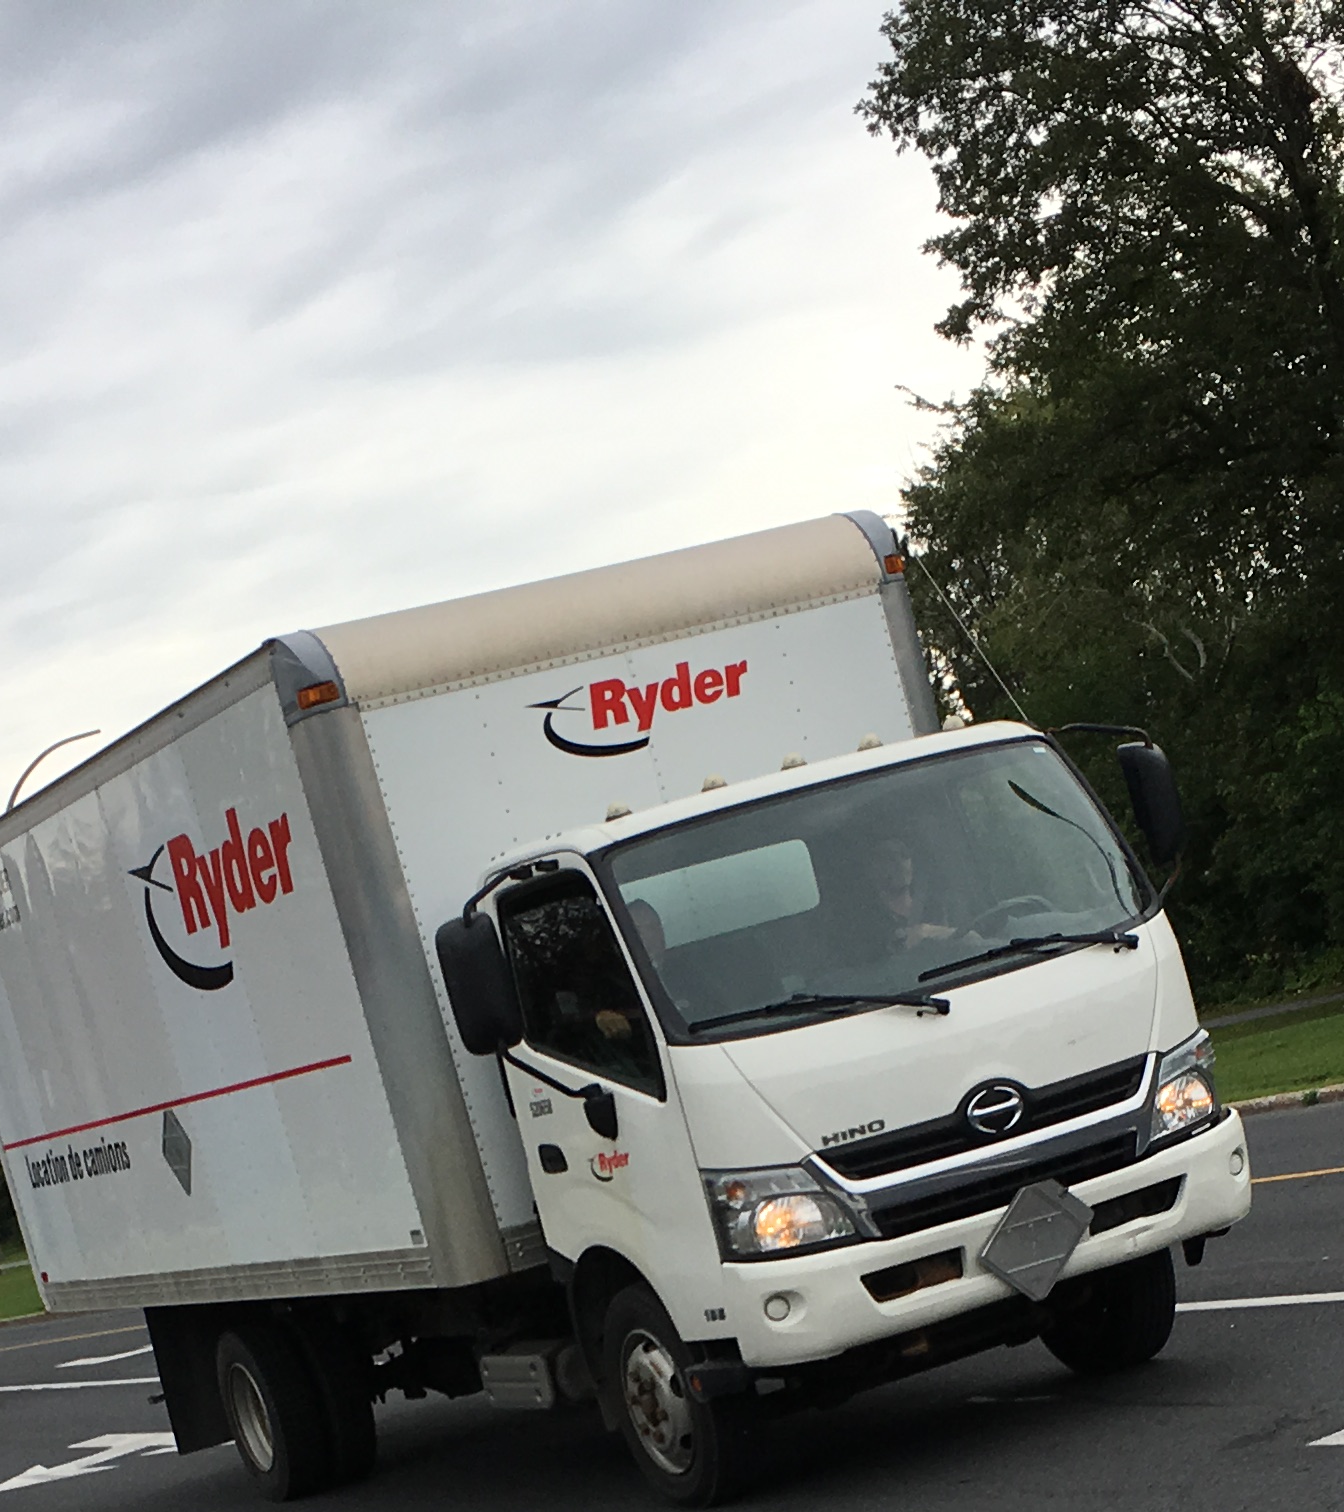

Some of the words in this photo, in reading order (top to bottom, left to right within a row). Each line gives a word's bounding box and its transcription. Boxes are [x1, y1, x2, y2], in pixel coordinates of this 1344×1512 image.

[589, 660, 747, 732] Ryder
[167, 807, 294, 949] Ryder
[821, 1119, 886, 1146] HINO
[25, 1149, 70, 1188] Location
[68, 1144, 84, 1180] de
[83, 1136, 130, 1177] camions
[598, 1150, 629, 1175] Ryder
